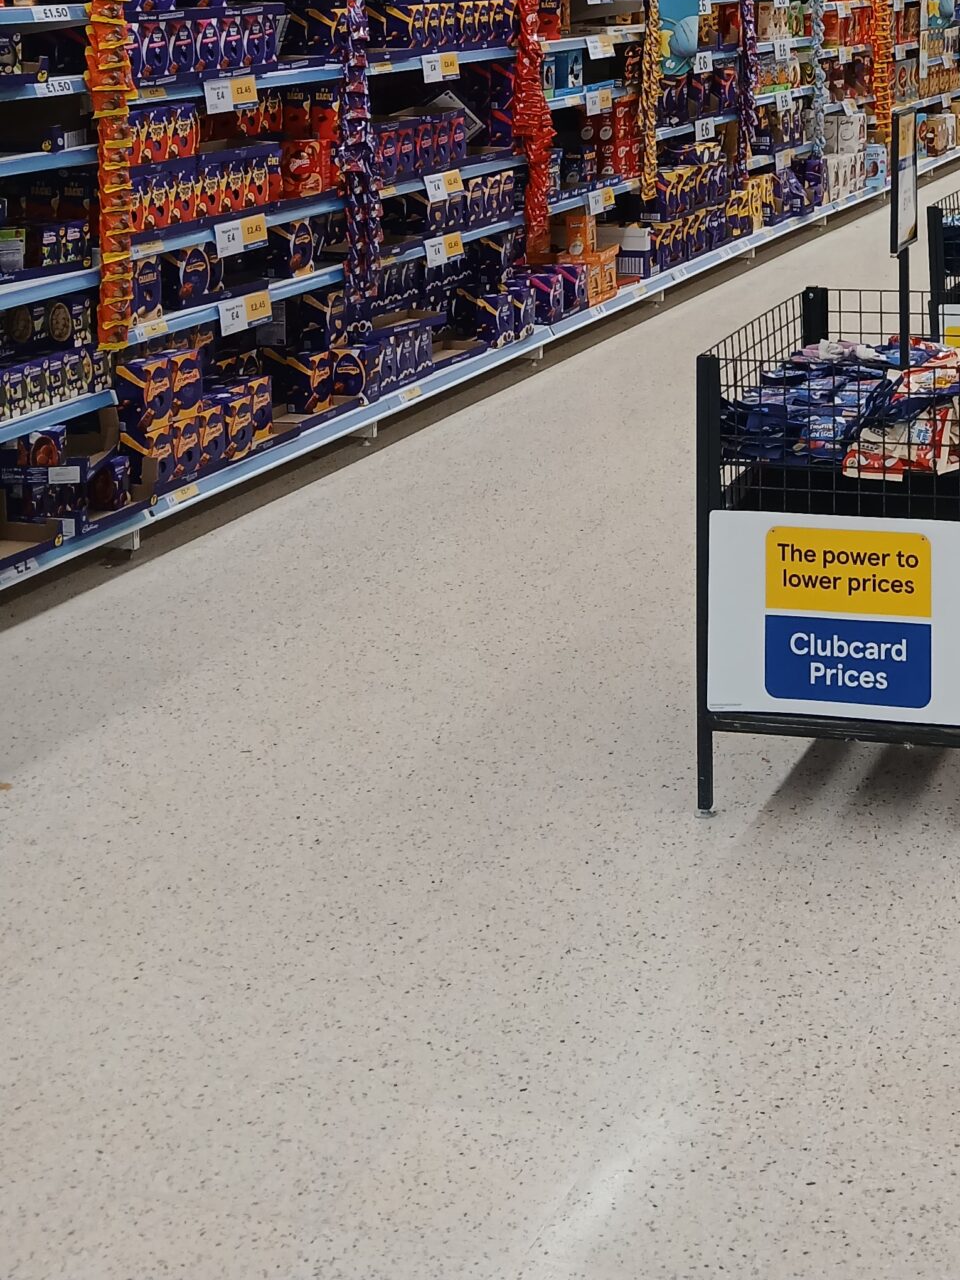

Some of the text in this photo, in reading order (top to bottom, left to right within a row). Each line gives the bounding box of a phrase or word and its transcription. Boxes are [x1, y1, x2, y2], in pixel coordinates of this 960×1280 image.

[43, 7, 68, 19] £1.50
[779, 44, 787, 57] £6
[699, 57, 708, 70] £6
[45, 81, 71, 93] £1.50
[217, 86, 252, 100] £4 £2.45
[780, 94, 789, 108] £6
[701, 125, 711, 137] £6
[227, 224, 262, 243] £4 £2.45
[231, 301, 266, 321] £4 £2.45
[777, 543, 919, 569] The power to
[783, 569, 915, 596] lower prices
[790, 632, 907, 662] Clubcard
[810, 662, 888, 689] Prices
